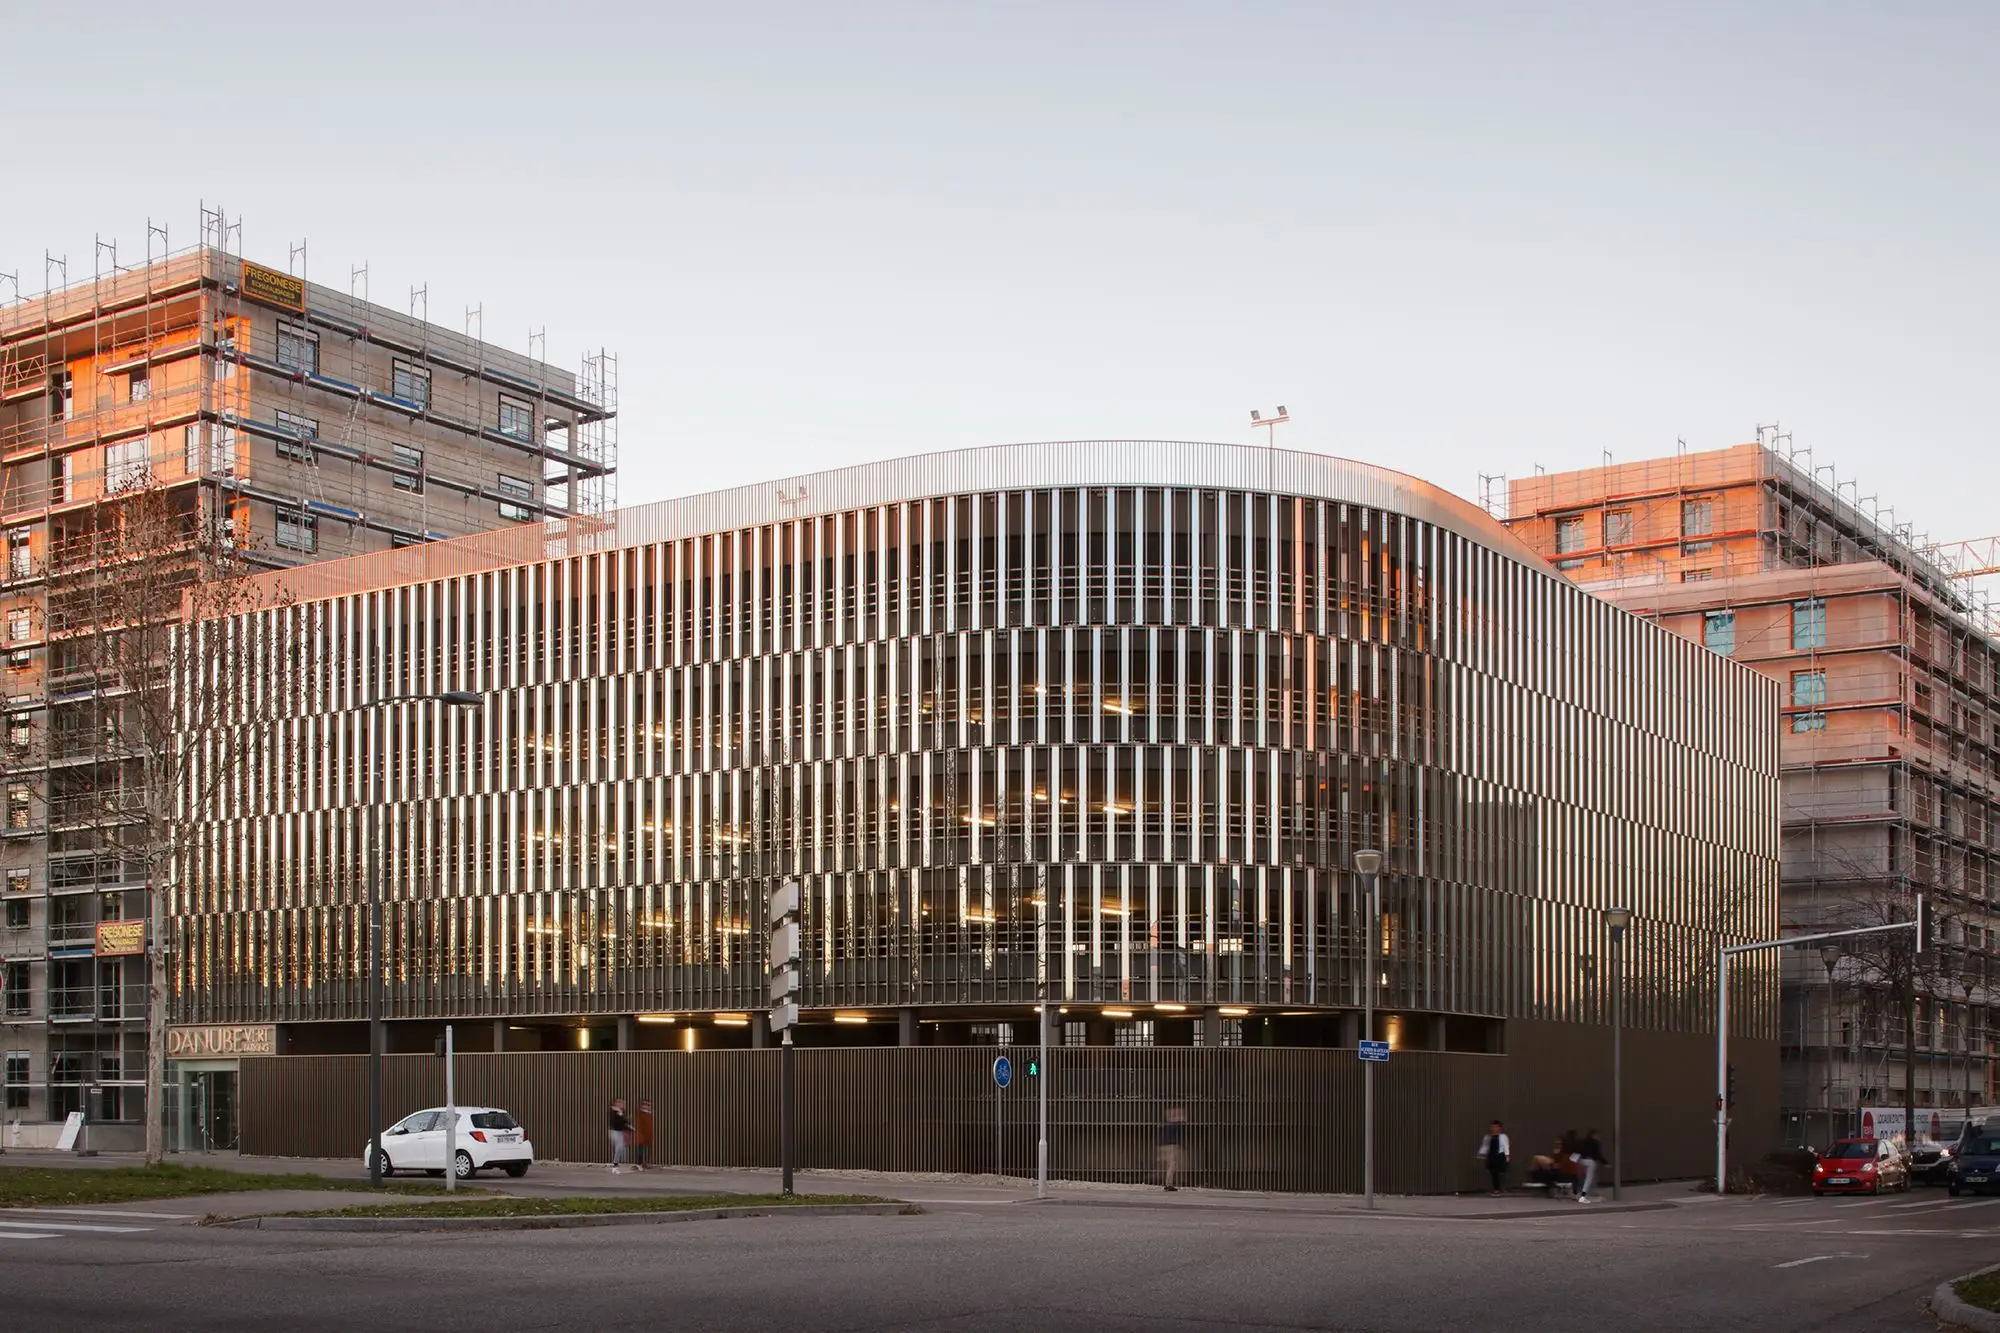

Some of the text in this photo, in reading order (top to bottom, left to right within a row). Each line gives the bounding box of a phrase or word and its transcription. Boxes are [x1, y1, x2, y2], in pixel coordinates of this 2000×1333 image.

[245, 264, 302, 294] FREGONESE
[99, 924, 143, 939] FREGONESE
[168, 1027, 270, 1053] DANUBE VERT
